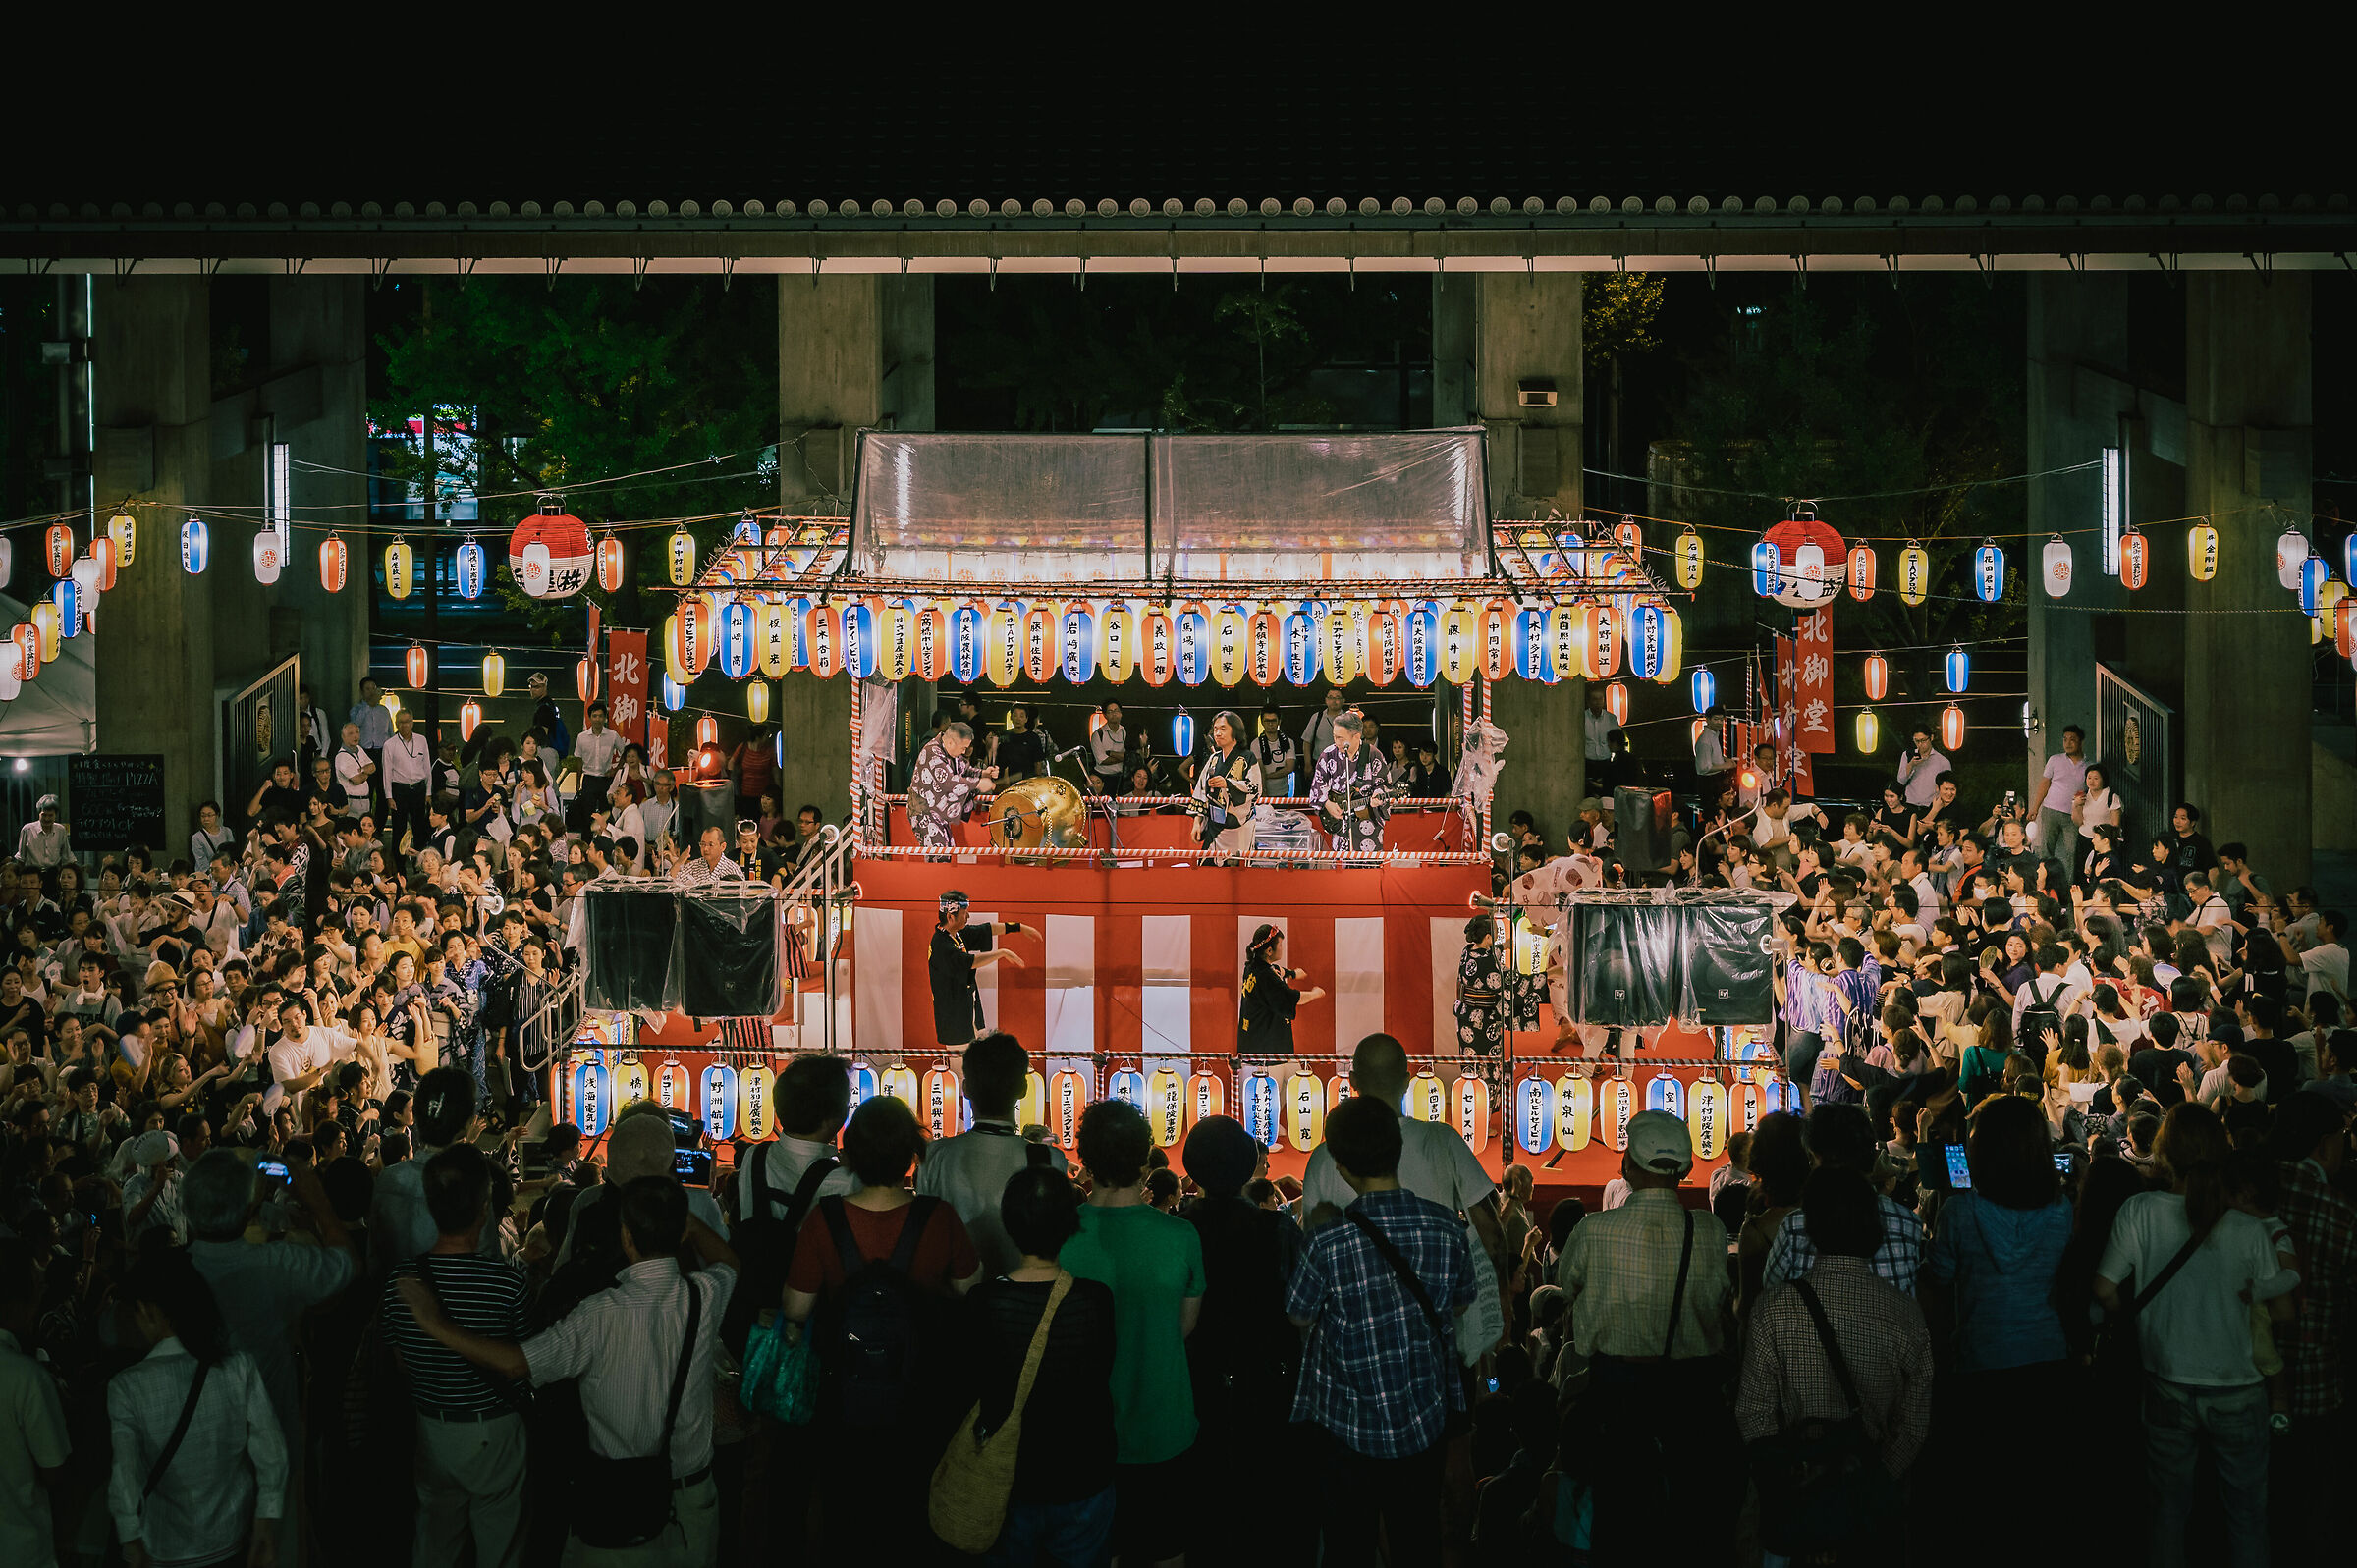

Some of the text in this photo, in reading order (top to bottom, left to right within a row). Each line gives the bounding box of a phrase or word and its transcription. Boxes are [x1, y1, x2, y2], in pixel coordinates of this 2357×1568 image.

[1222, 624, 1233, 673] 石神家
[1448, 624, 1460, 672] 藤井家
[1802, 609, 1829, 733] 北御堂
[1463, 1094, 1473, 1142] セレスポ
